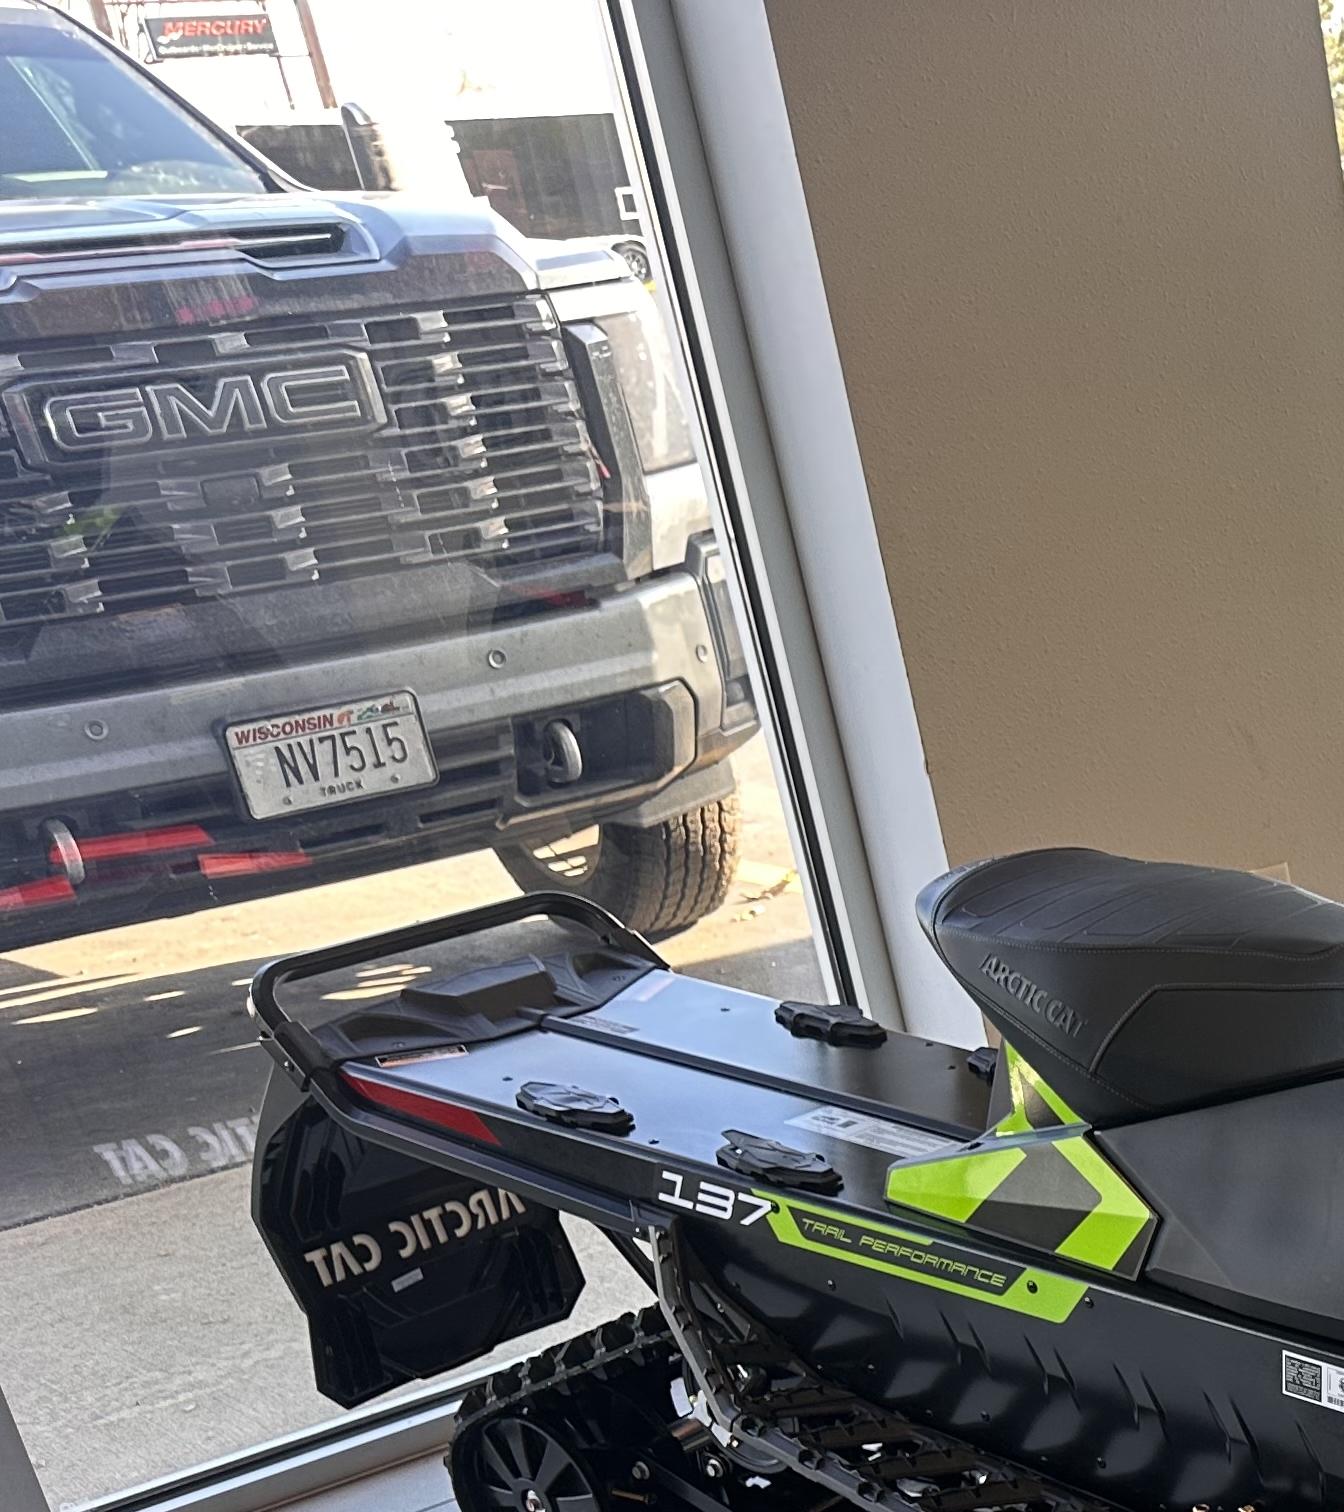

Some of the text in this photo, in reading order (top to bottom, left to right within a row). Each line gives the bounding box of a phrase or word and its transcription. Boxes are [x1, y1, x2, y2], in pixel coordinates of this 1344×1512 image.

[162, 18, 267, 37] MERCURY
[43, 365, 361, 451] GMC
[235, 713, 334, 746] WISCONSIN
[274, 721, 408, 788] NV7515
[320, 780, 364, 797] TRUCK
[979, 953, 1089, 1038] ARCTIC CAT
[658, 1170, 773, 1226] 137
[802, 1218, 1007, 1288] TRAIL PERFORMANCE
